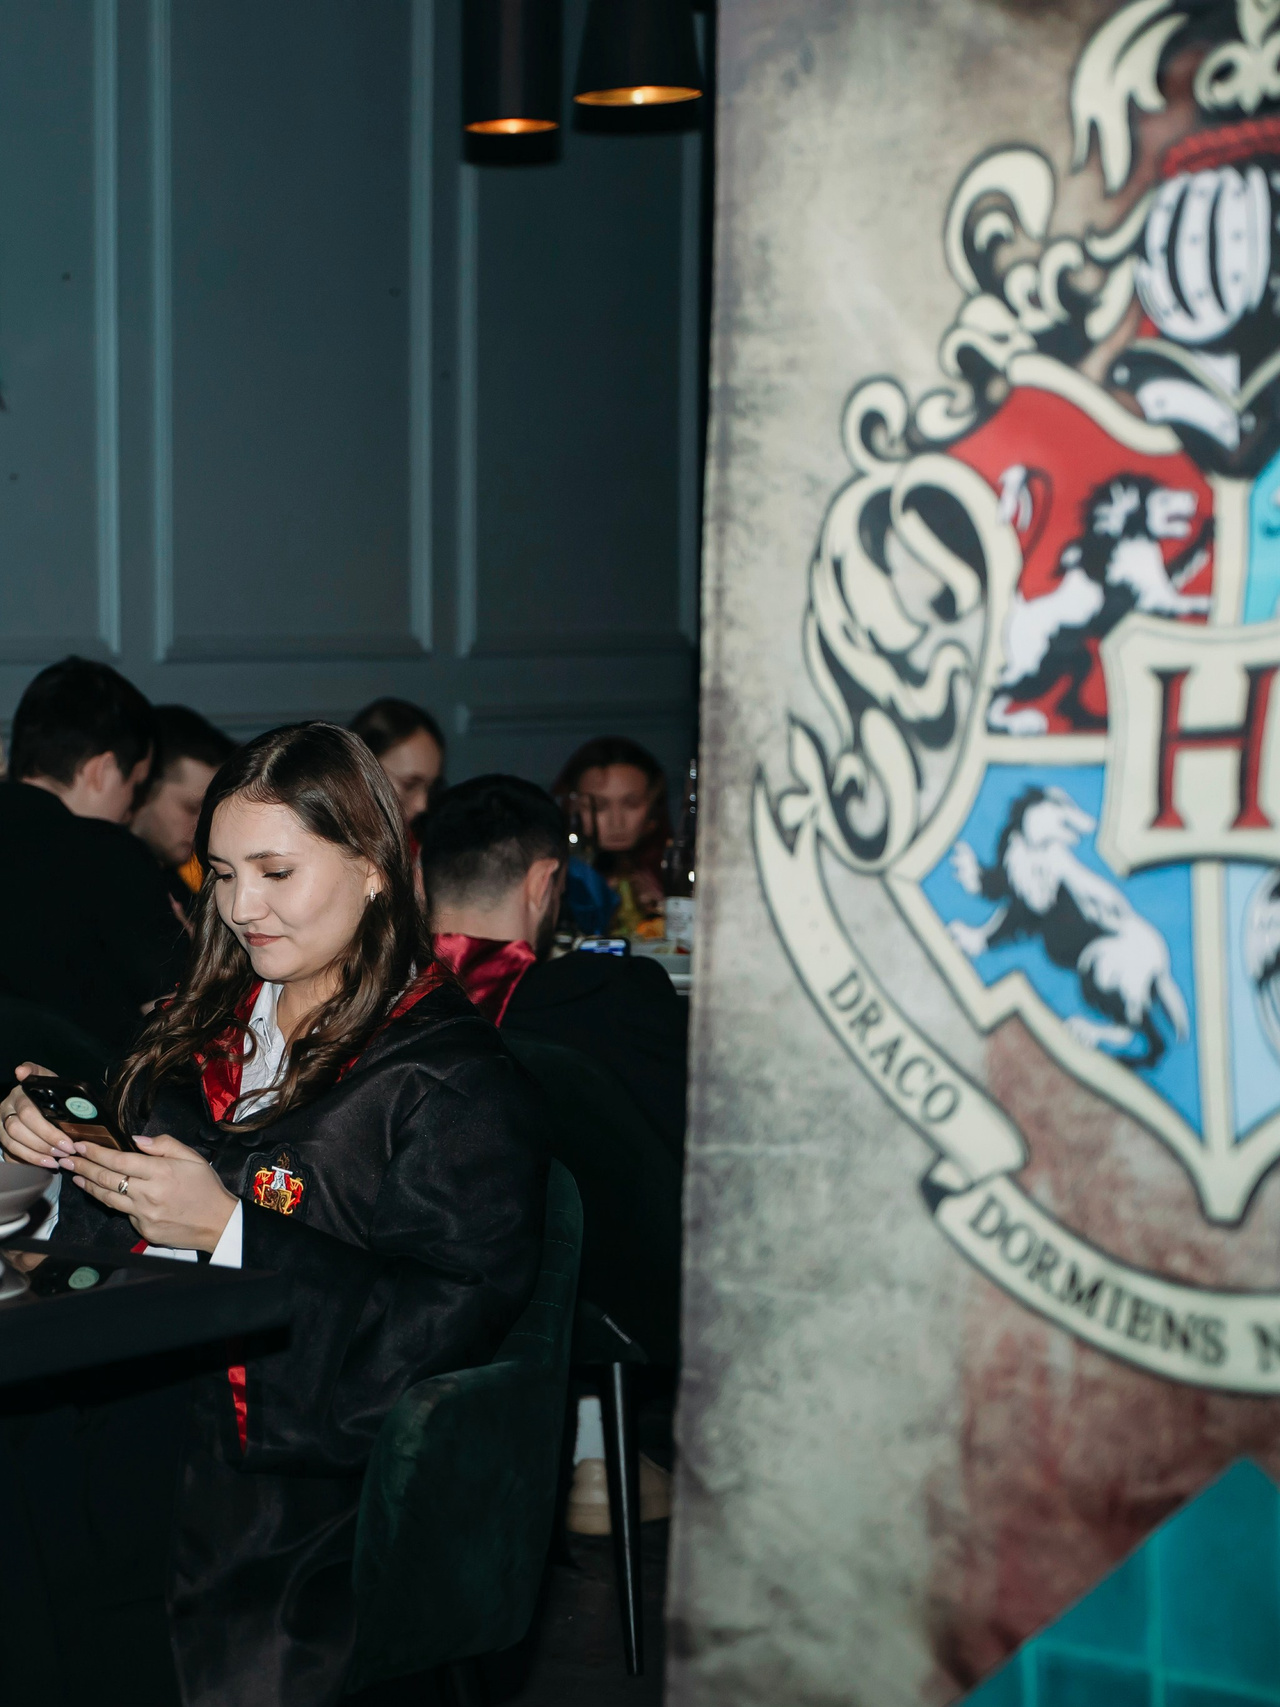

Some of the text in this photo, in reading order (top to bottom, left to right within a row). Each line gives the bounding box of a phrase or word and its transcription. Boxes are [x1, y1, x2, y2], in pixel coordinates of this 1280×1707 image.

[1147, 666, 1280, 830] H
[828, 970, 961, 1124] DRACO
[968, 1195, 1227, 1367] DORMIENS
